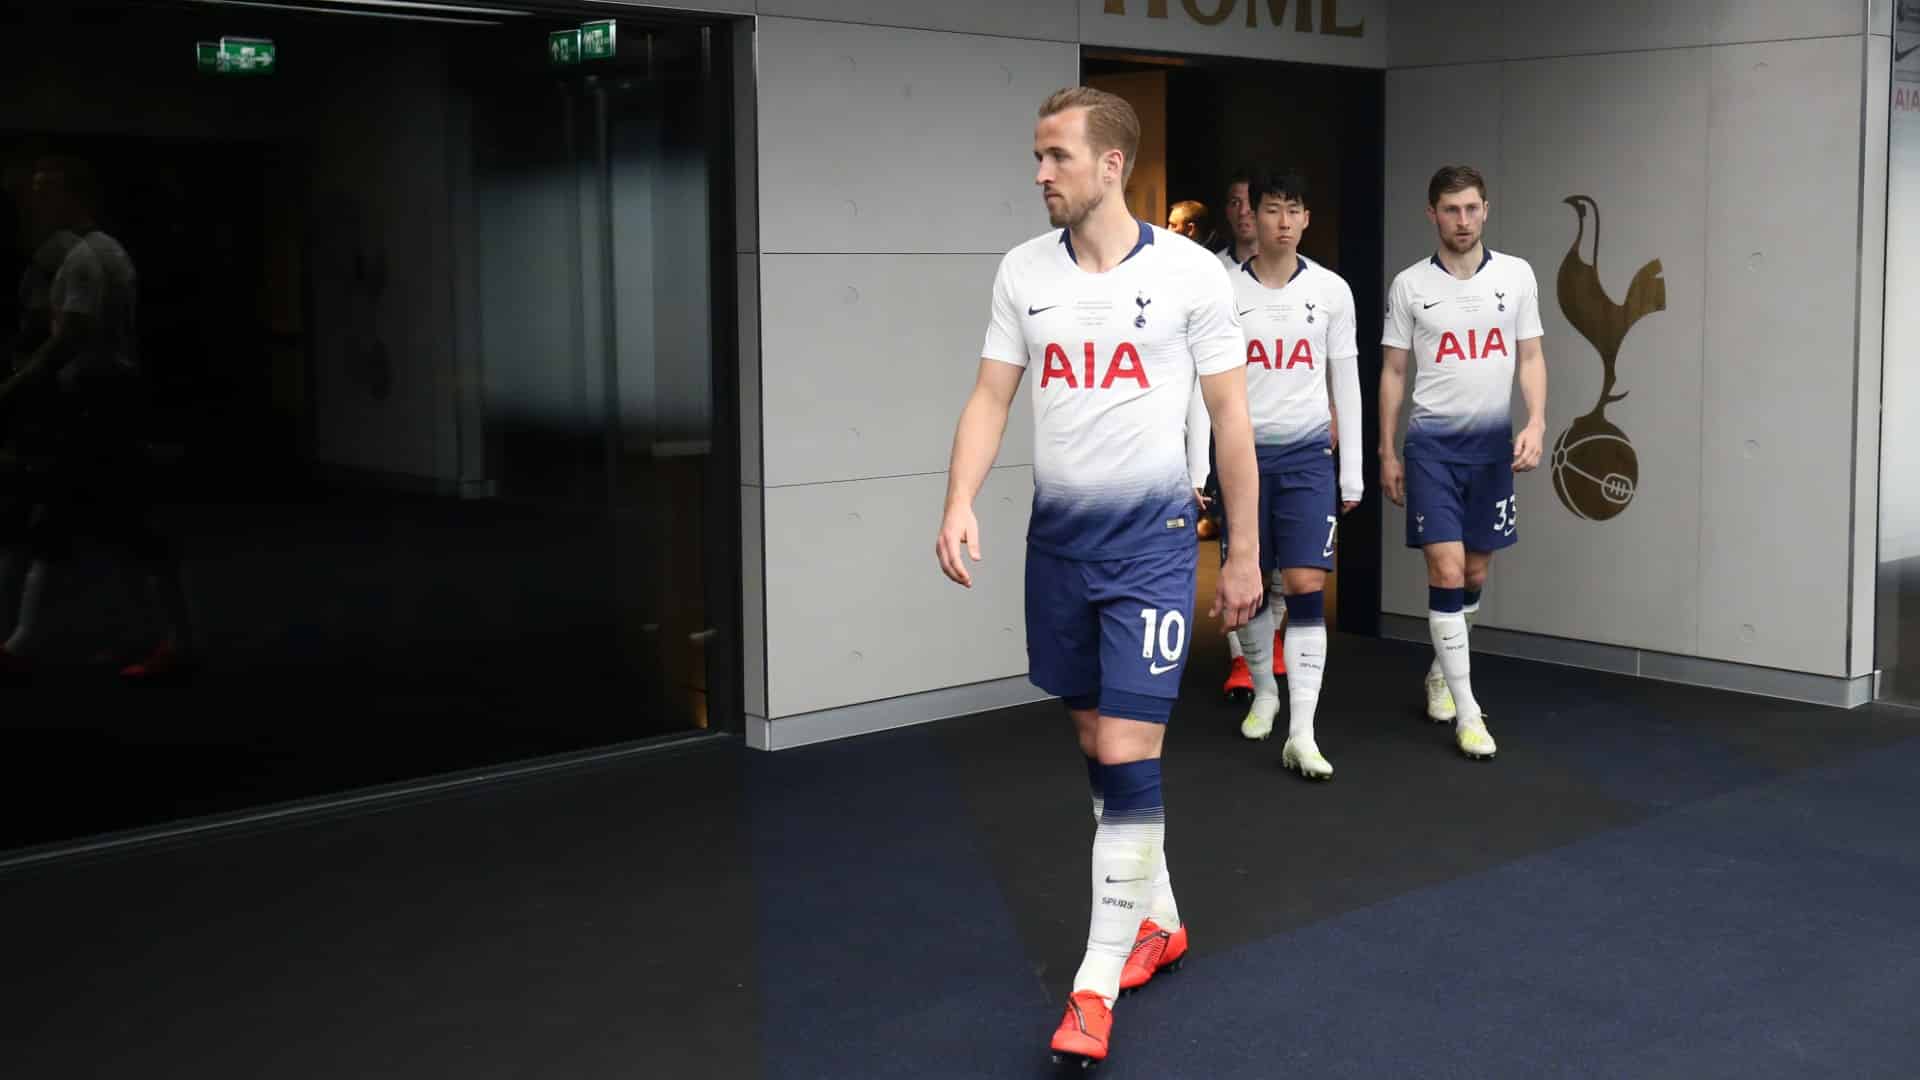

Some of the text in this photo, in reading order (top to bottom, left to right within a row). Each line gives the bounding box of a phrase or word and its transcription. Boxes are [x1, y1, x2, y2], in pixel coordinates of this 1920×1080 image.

[1247, 338, 1313, 370] AIA
[1435, 327, 1507, 363] AIA
[1040, 342, 1150, 388] AIA
[1140, 608, 1185, 661] 10
[1102, 896, 1134, 910] SPURS
